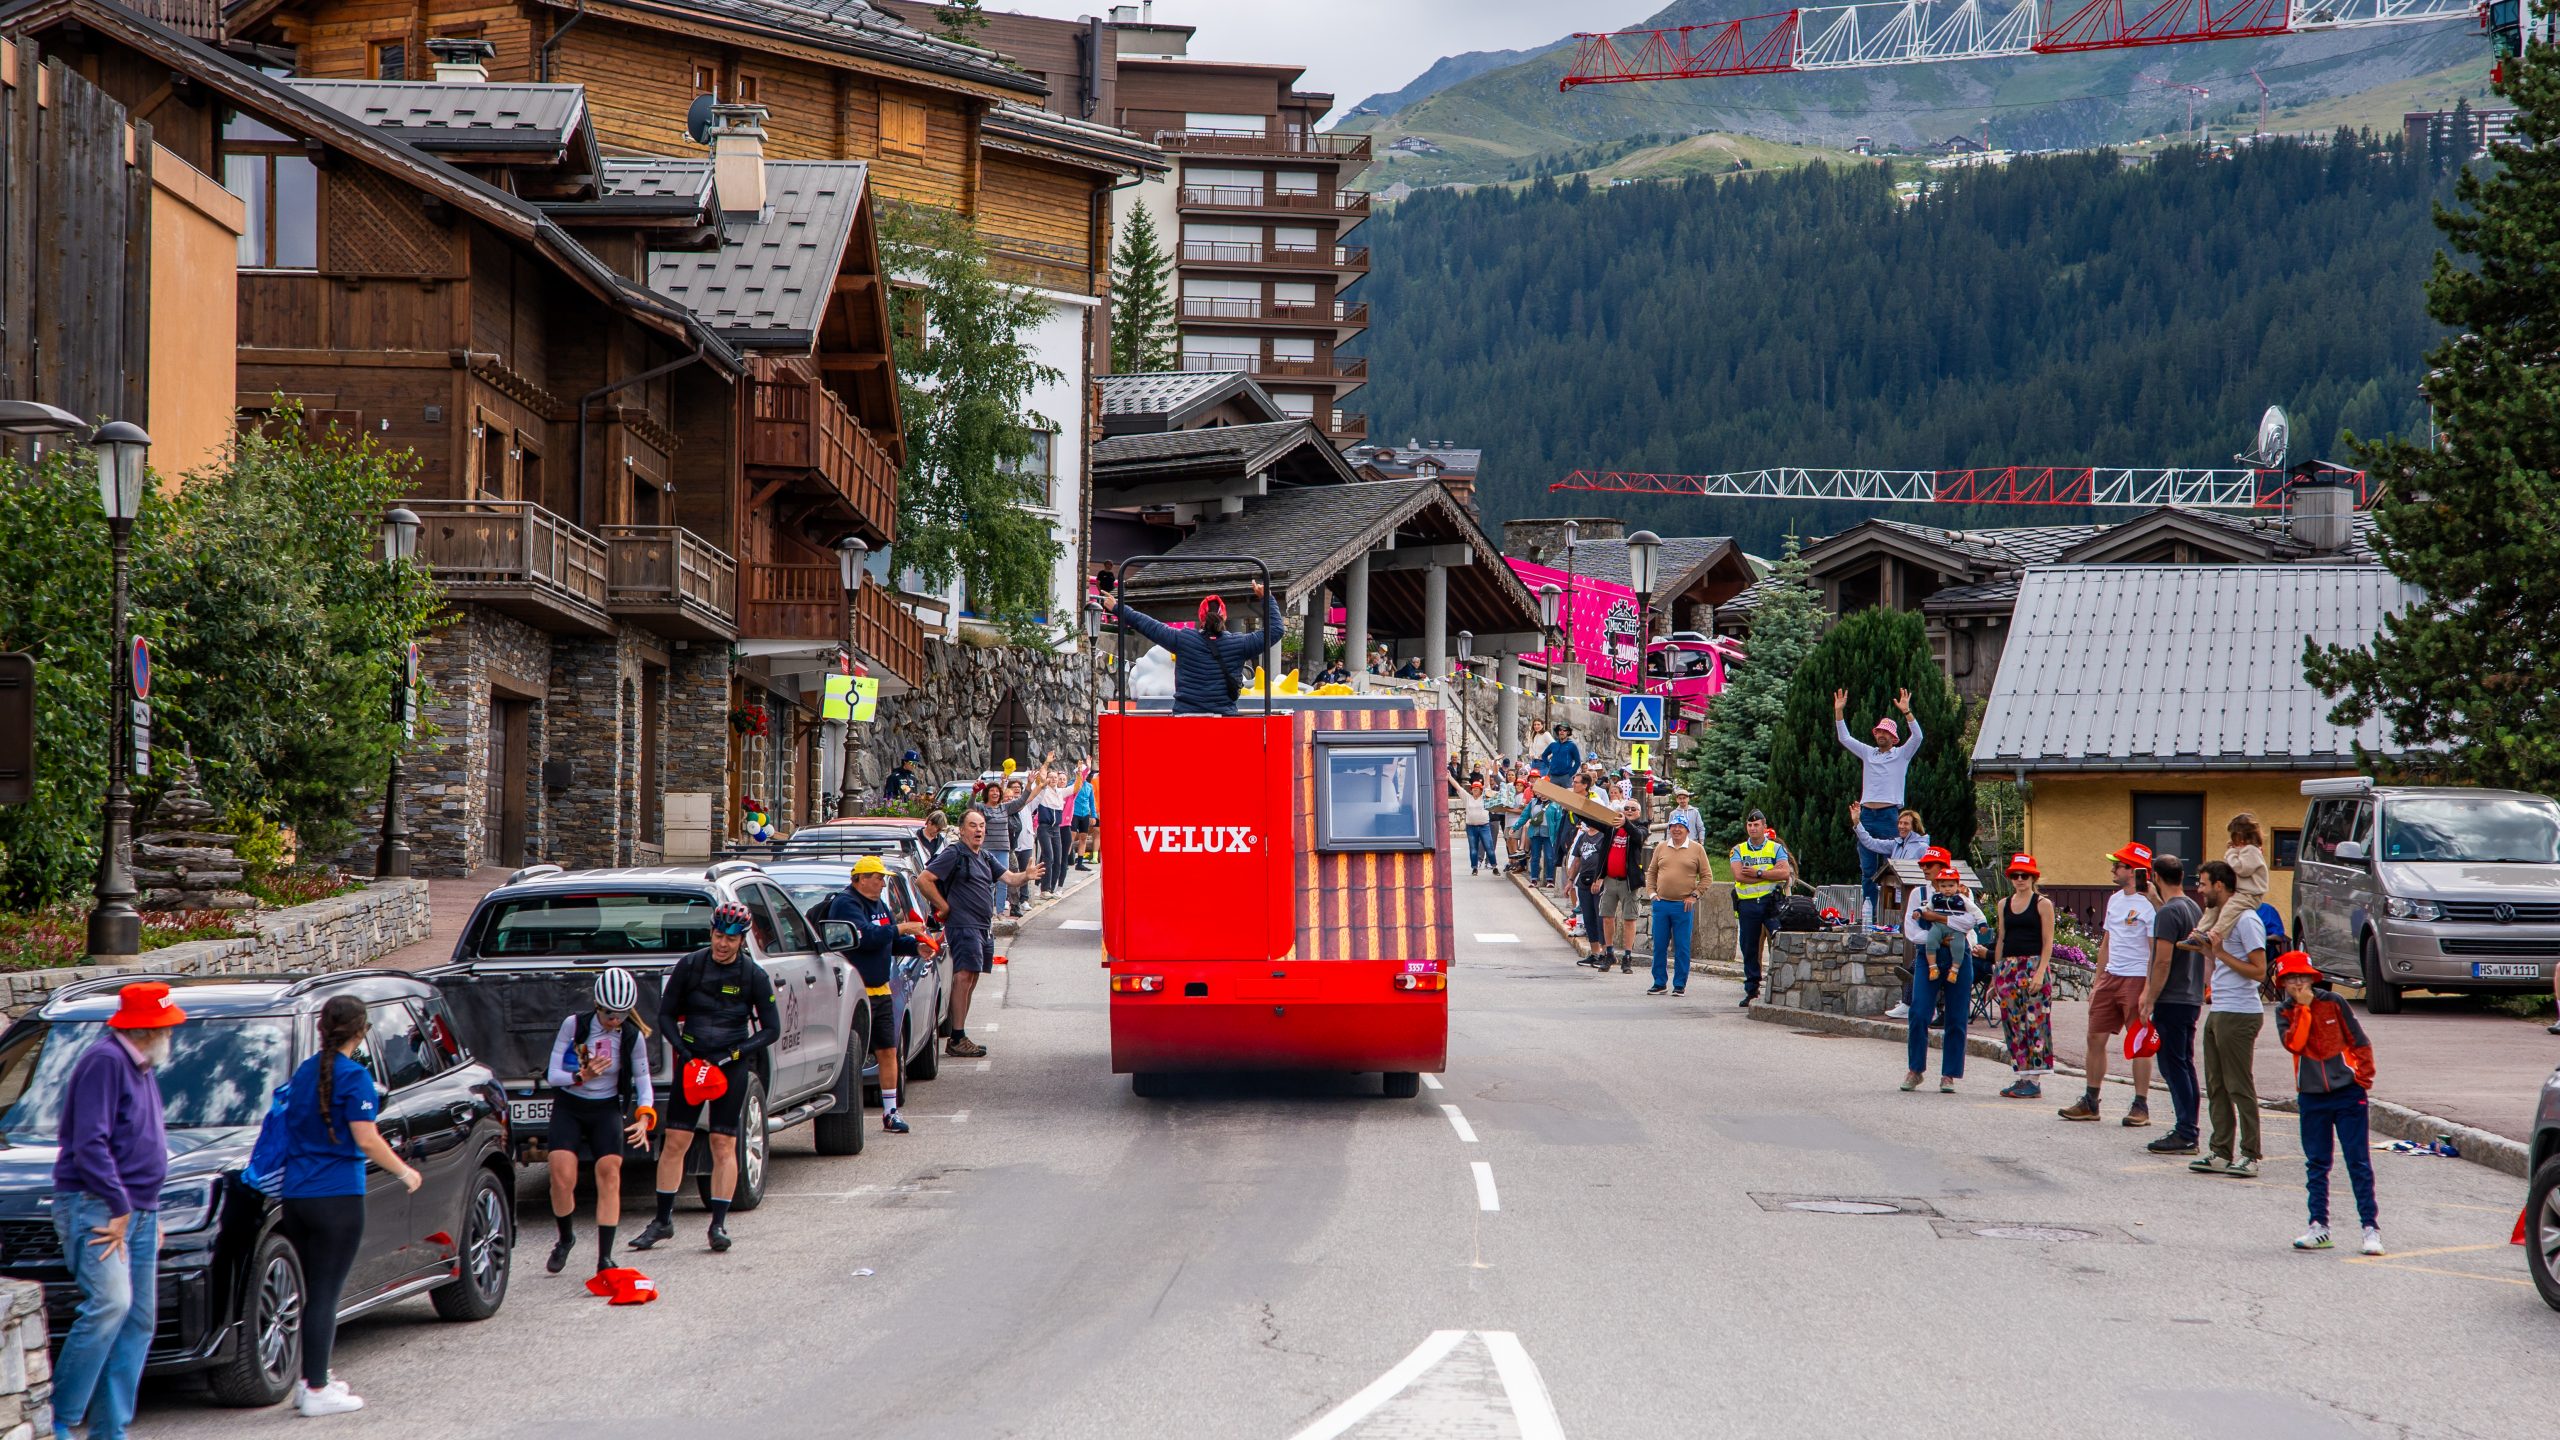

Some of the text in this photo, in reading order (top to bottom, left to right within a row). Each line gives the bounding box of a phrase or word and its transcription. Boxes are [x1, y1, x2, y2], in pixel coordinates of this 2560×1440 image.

[1408, 963, 1424, 972] 3357
[2480, 965, 2493, 975] HS
[2513, 965, 2537, 976] 1111
